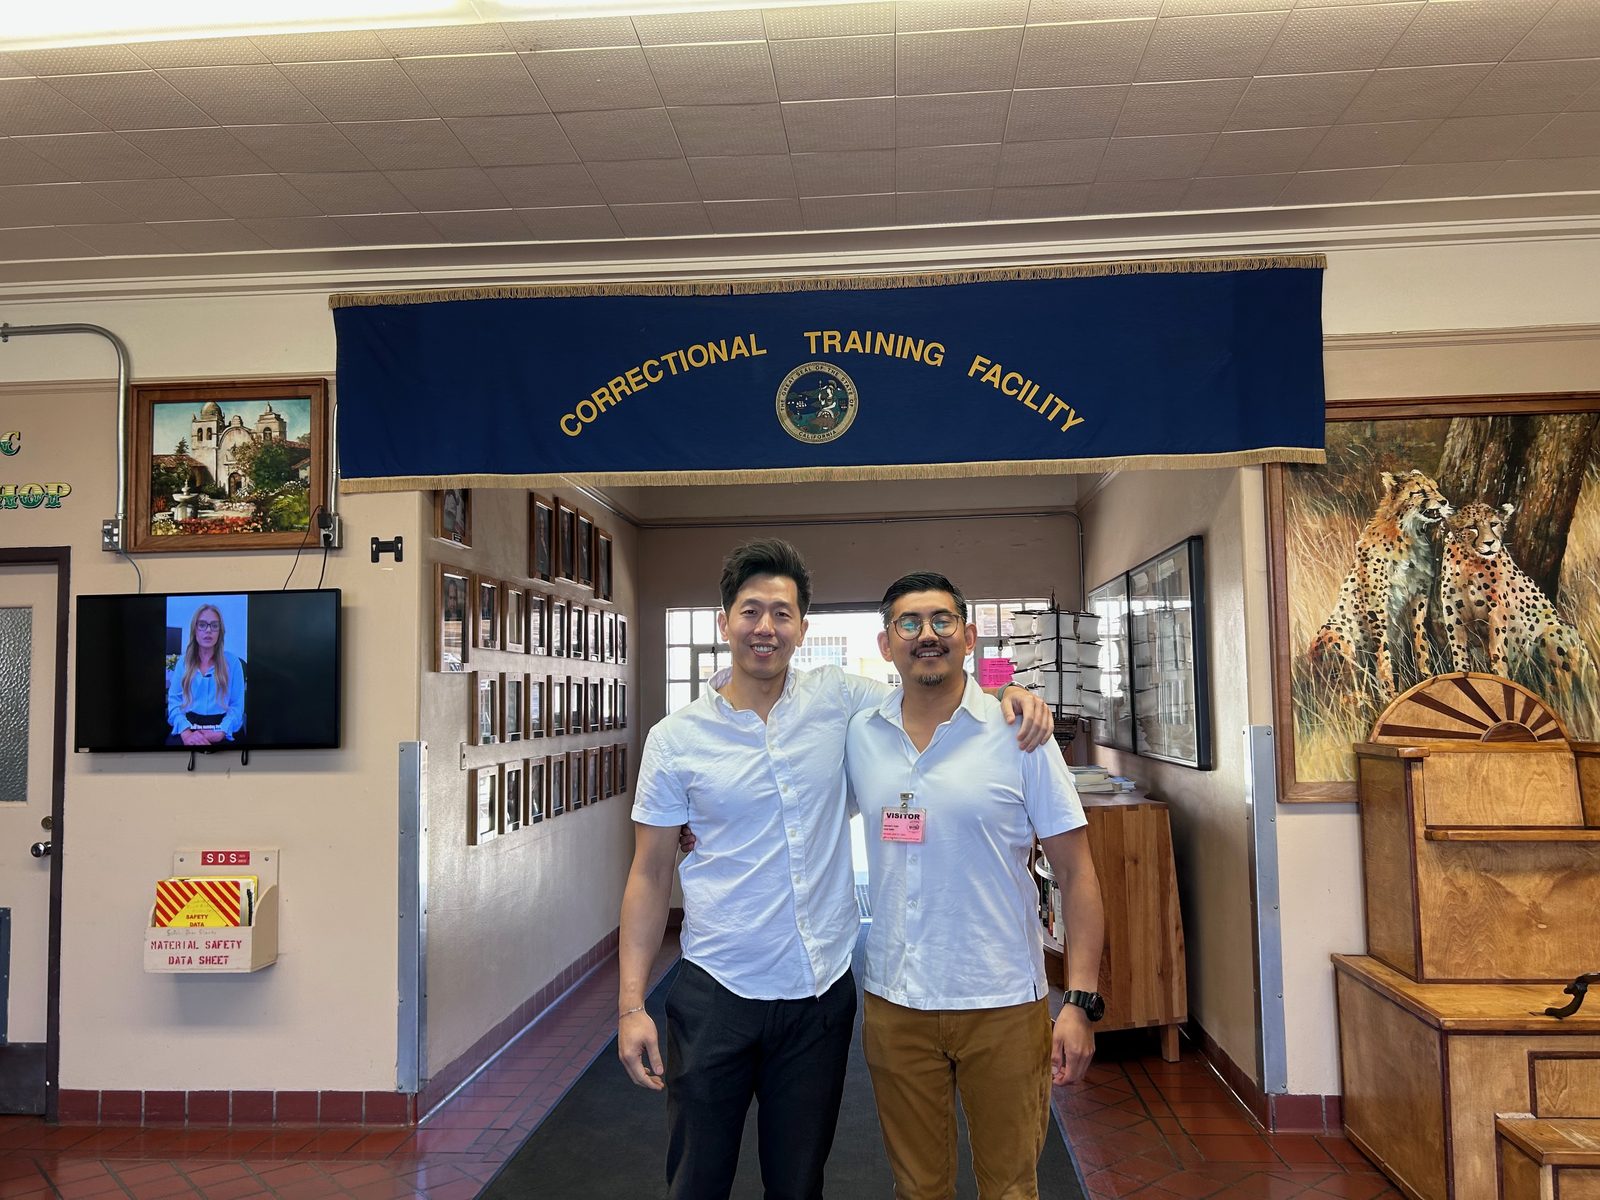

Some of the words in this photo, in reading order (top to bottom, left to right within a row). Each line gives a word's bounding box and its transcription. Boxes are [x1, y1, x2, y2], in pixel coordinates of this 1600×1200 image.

[796, 368, 811, 376] SEAL
[827, 367, 839, 376] THE
[559, 333, 767, 437] CORRECTIONAL
[803, 330, 945, 366] TRAINING
[967, 354, 1085, 433] FACILITY
[798, 431, 837, 439] CALIFORNIA
[886, 812, 920, 820] VISITOR
[150, 940, 200, 950] MATERIAL
[205, 940, 242, 950] SAFETY
[168, 956, 193, 965] DATA
[198, 956, 229, 965] SHEET
